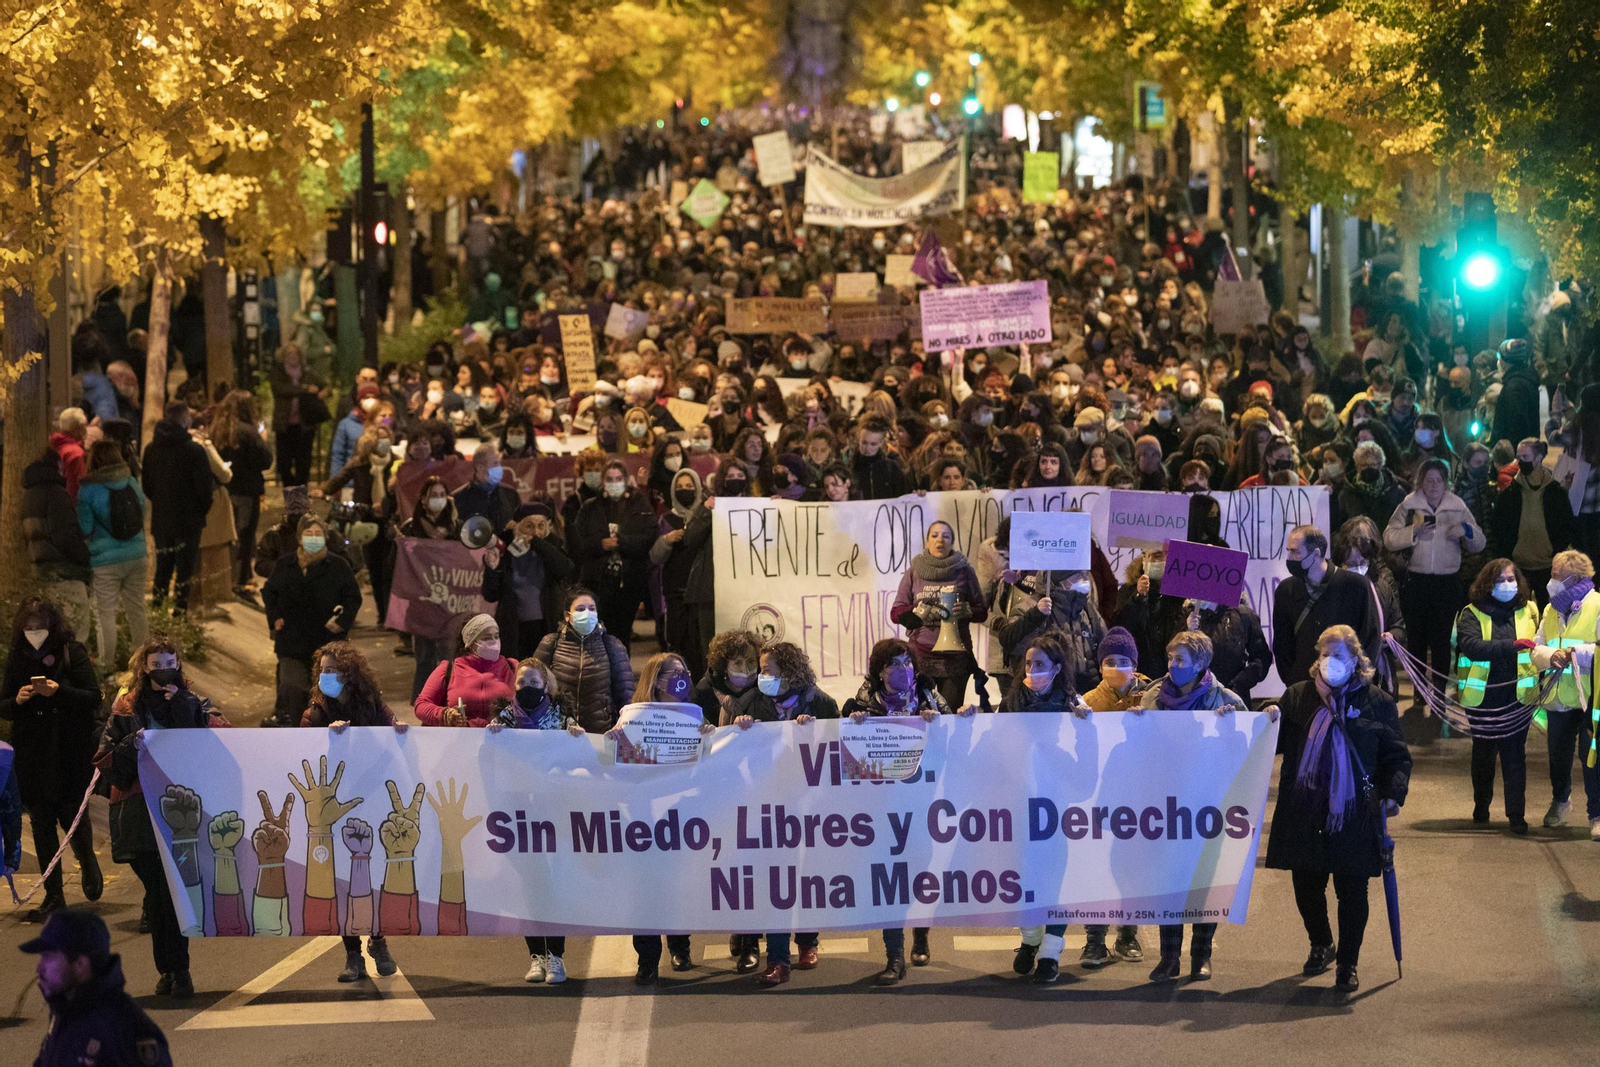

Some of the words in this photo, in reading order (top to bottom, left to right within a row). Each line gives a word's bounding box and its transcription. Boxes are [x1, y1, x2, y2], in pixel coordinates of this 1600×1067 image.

[929, 338, 942, 348] NO
[946, 335, 971, 346] MIRES
[976, 334, 983, 343] A
[988, 331, 1015, 342] OTRO
[1018, 329, 1046, 340] LADO
[1111, 511, 1186, 529] IGUALDAD
[729, 505, 831, 579] FRENTE
[837, 543, 860, 579] al
[1031, 538, 1077, 549] agrafem
[452, 568, 484, 588] VIVAS
[1167, 558, 1242, 587] APOYO
[485, 810, 556, 854] Sin
[570, 808, 722, 860] Miedo,
[736, 803, 875, 850] Libres
[887, 811, 913, 856] y
[927, 798, 1013, 843] Con
[1028, 796, 1255, 842] Derechos
[710, 865, 754, 911] Ni
[769, 864, 856, 909] Una
[870, 861, 1035, 906] Menos.
[1047, 909, 1106, 919] Plataforma
[1108, 909, 1124, 919] 8M
[1126, 912, 1133, 921] y
[1135, 909, 1155, 919] 25N
[1163, 908, 1219, 919] Feminismo
